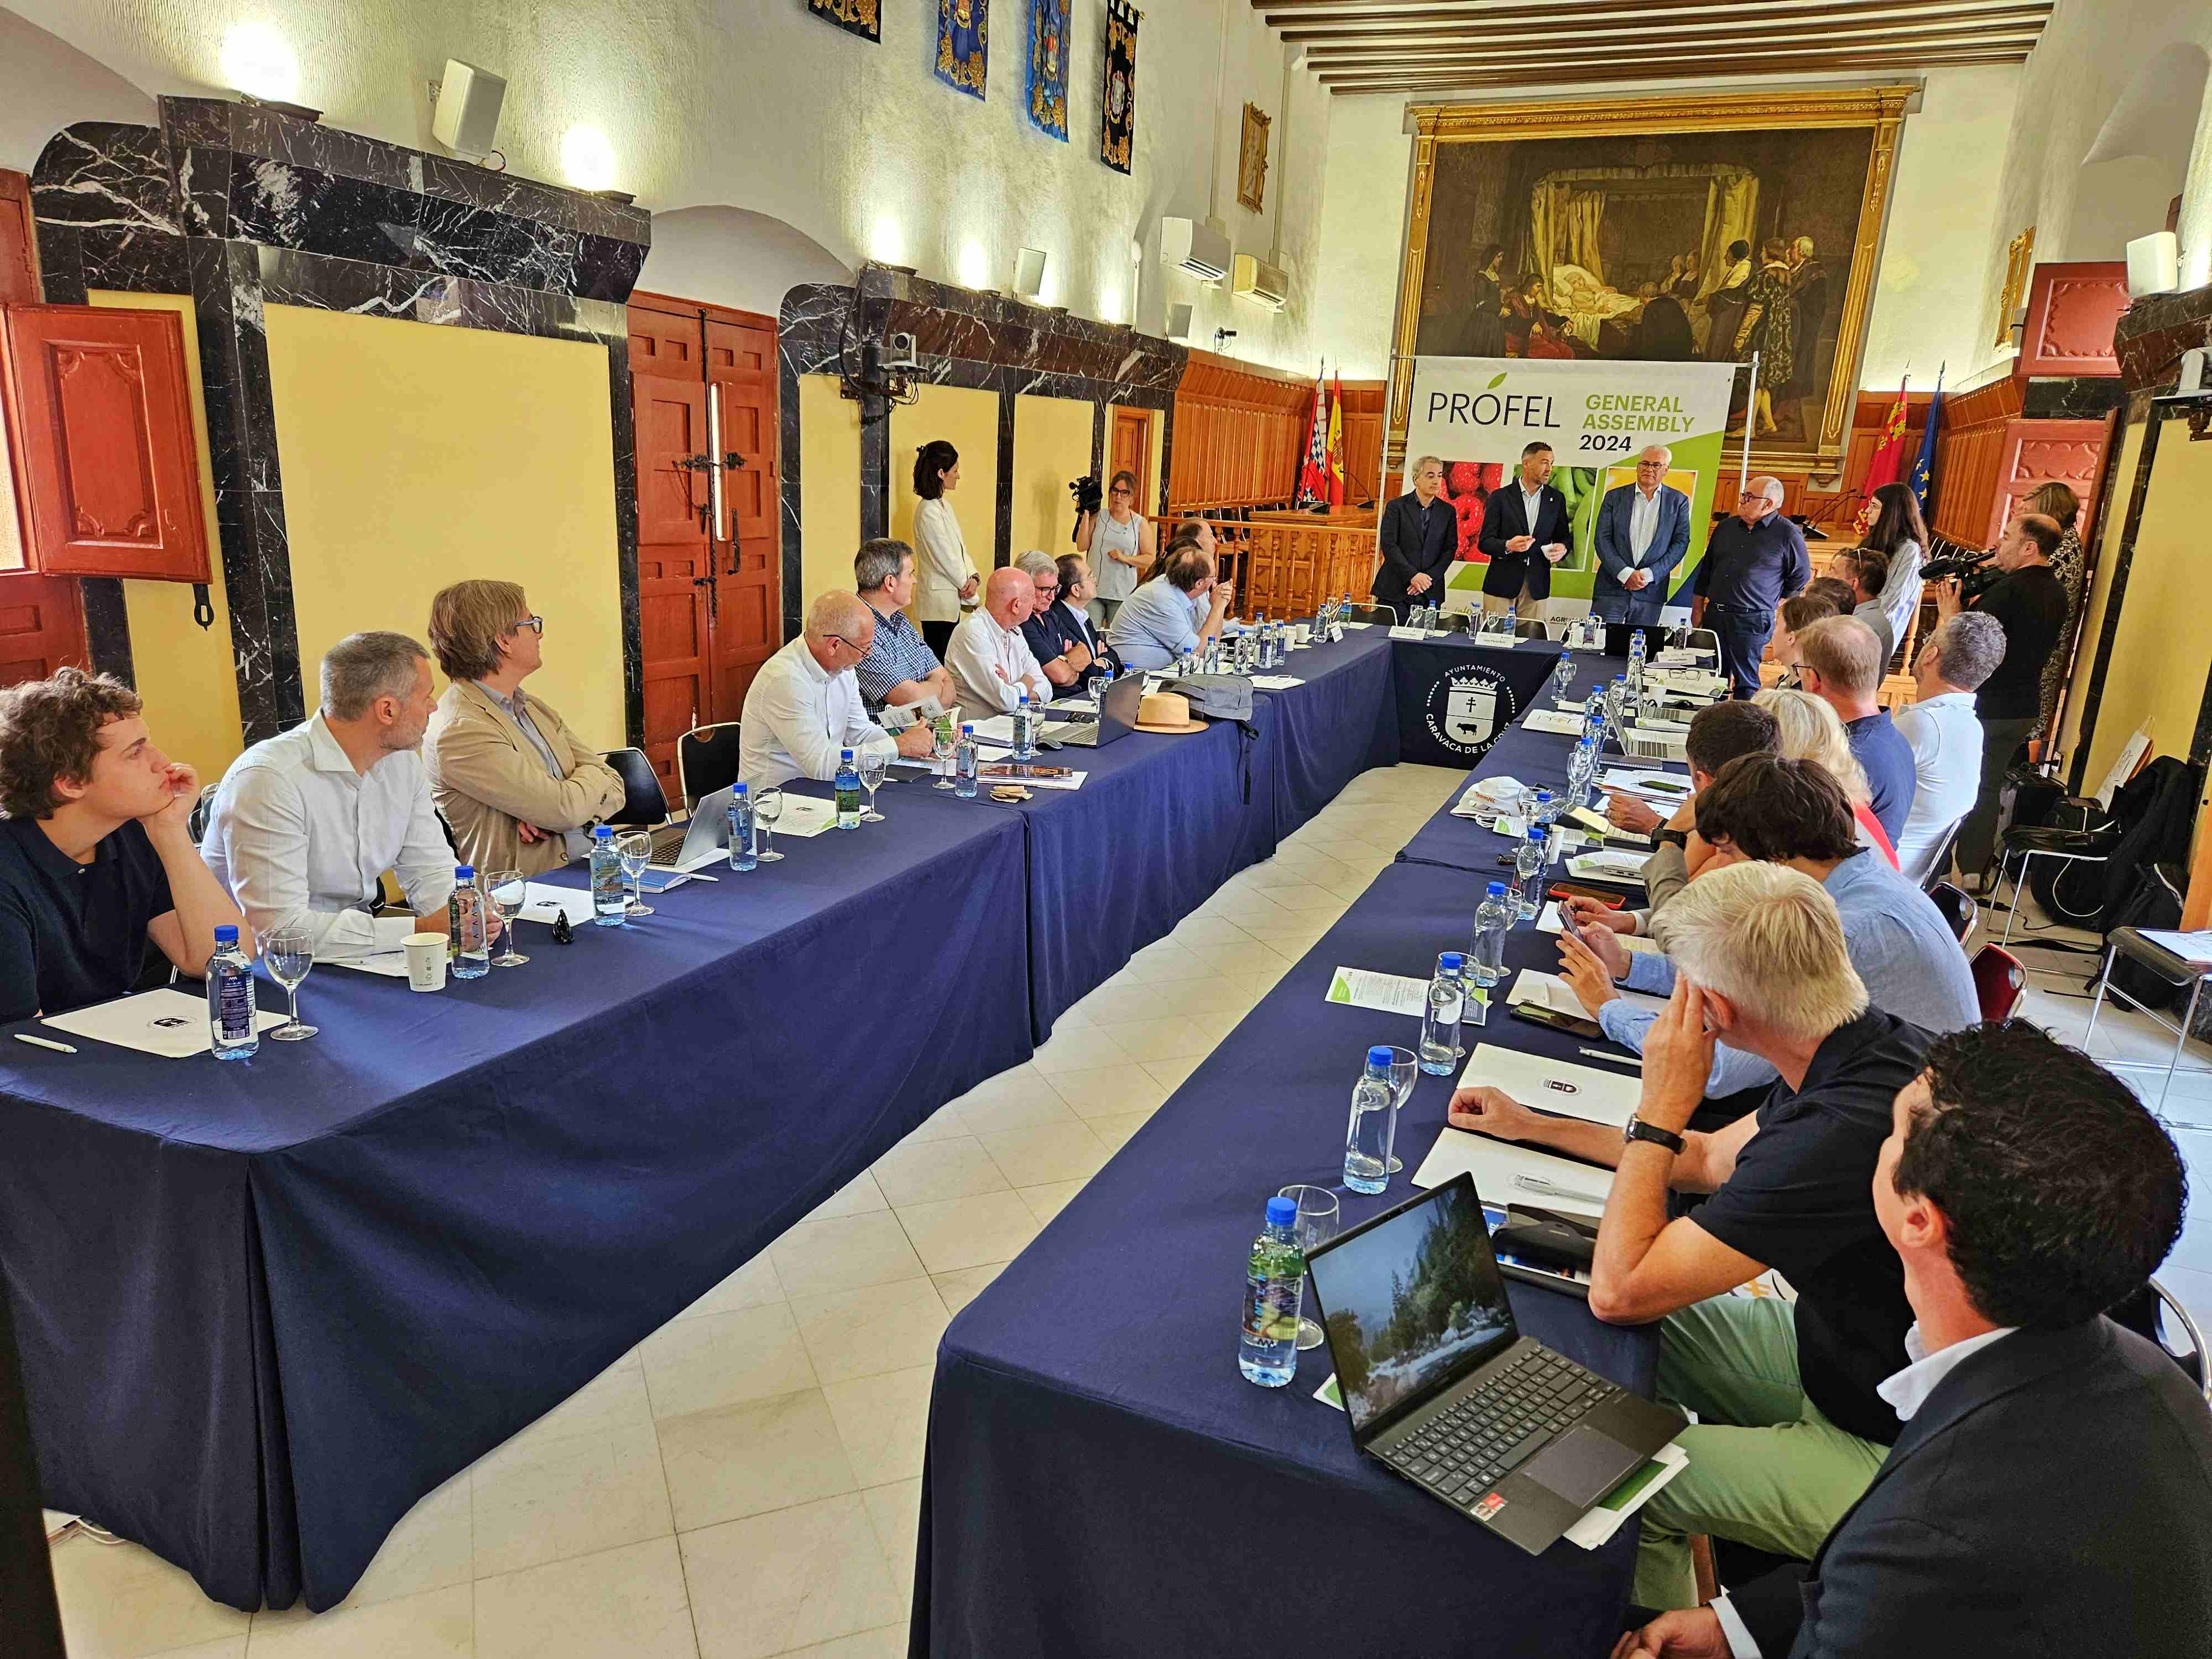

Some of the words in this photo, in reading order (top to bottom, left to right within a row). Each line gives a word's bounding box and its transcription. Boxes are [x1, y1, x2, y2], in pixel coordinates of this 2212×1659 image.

[1427, 392, 1561, 428] PROFEL
[1585, 394, 1684, 413] GENERAL
[1582, 413, 1695, 432] ASSEMBLY
[1579, 435, 1632, 452] 2024
[1444, 664, 1505, 682] AYUNTAMIENTO
[1426, 713, 1462, 753] CARAVACA
[1480, 742, 1493, 752] LA
